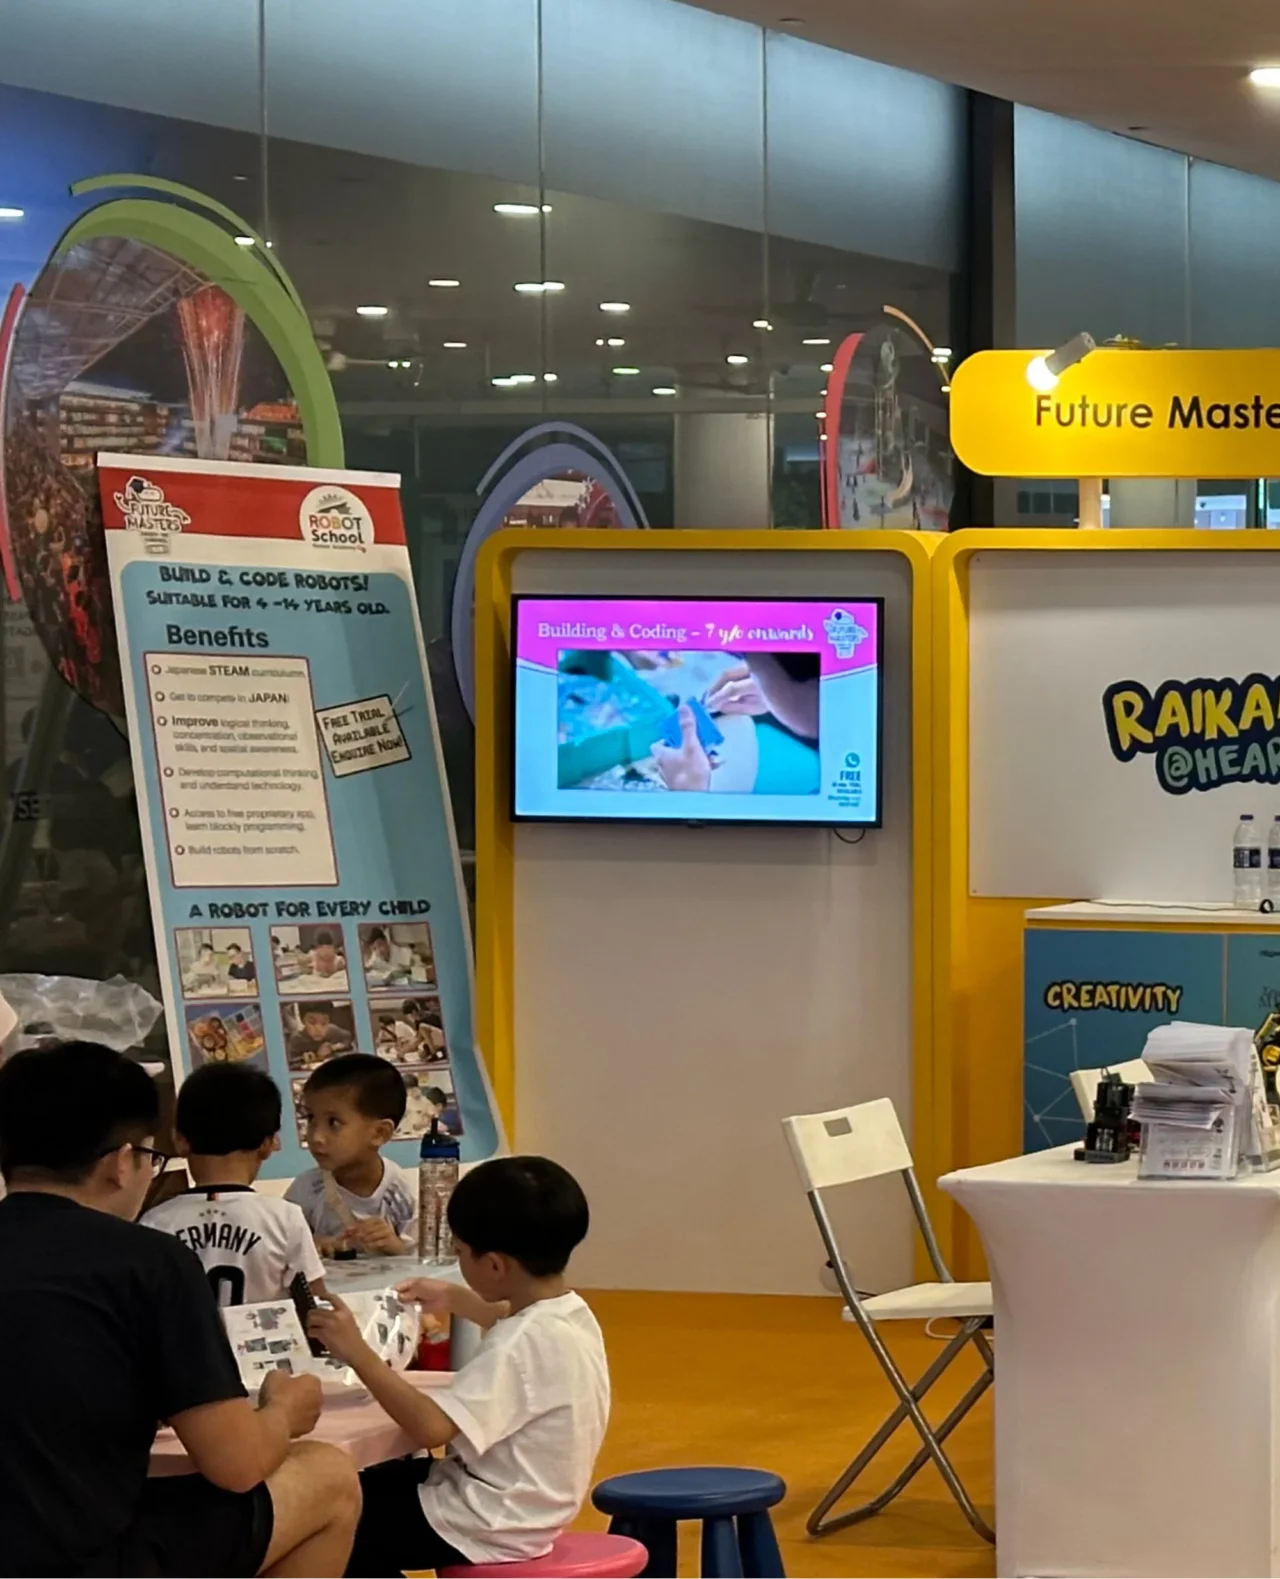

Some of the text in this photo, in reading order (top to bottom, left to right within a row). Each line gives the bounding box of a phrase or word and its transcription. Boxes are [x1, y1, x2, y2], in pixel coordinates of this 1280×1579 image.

[1035, 394, 1153, 429] Future
[127, 516, 180, 531] MASTERS
[309, 514, 362, 530] ROBOT
[311, 529, 364, 544] School
[159, 565, 369, 591] BUILD & CODE ROBOTS!
[146, 590, 216, 607] SUITABLE
[222, 594, 251, 609] FOR
[304, 599, 352, 614] YEARS
[357, 602, 390, 615] OLD.
[166, 624, 269, 648] Benefits
[538, 622, 607, 642] Building
[610, 622, 625, 638] &
[629, 623, 687, 643] Coding
[704, 623, 716, 639] 7
[747, 624, 814, 641] onwards
[209, 665, 250, 677] STEAM
[197, 693, 236, 704] compete
[172, 715, 218, 728] Improve
[220, 718, 250, 729] logical
[322, 707, 386, 730] FREE TRIAL
[332, 722, 391, 745] AVAILABLE
[200, 743, 218, 753] and
[331, 743, 377, 764] ENQUIRE
[178, 768, 215, 778] Develop
[216, 768, 281, 778] computational
[180, 782, 197, 790] and
[199, 782, 250, 790] understand
[227, 809, 244, 818] free
[188, 845, 211, 854] Build
[213, 846, 241, 855] robots
[243, 845, 263, 854] from
[189, 899, 431, 919] A ROBOT FOR EVERY CHILD
[1045, 981, 1183, 1014] CREATIVITY
[175, 1221, 262, 1257] ERMANY
